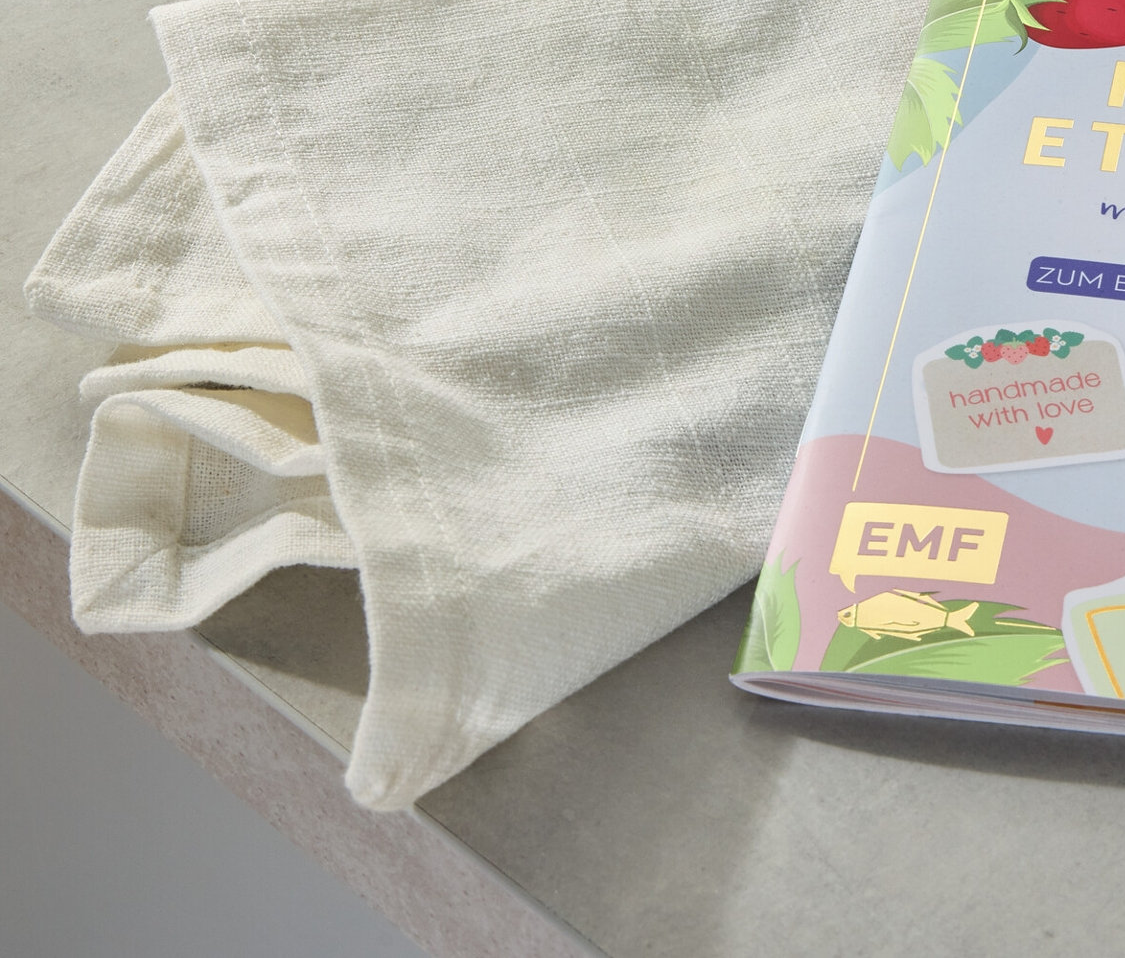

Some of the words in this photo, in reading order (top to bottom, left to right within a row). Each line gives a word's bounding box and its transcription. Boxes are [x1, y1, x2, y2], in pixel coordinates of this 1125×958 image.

[1036, 266, 1103, 289] ZUM
[950, 369, 1101, 408] handmade
[969, 403, 1030, 430] with
[1037, 395, 1095, 418] love
[856, 521, 986, 561] EMF
